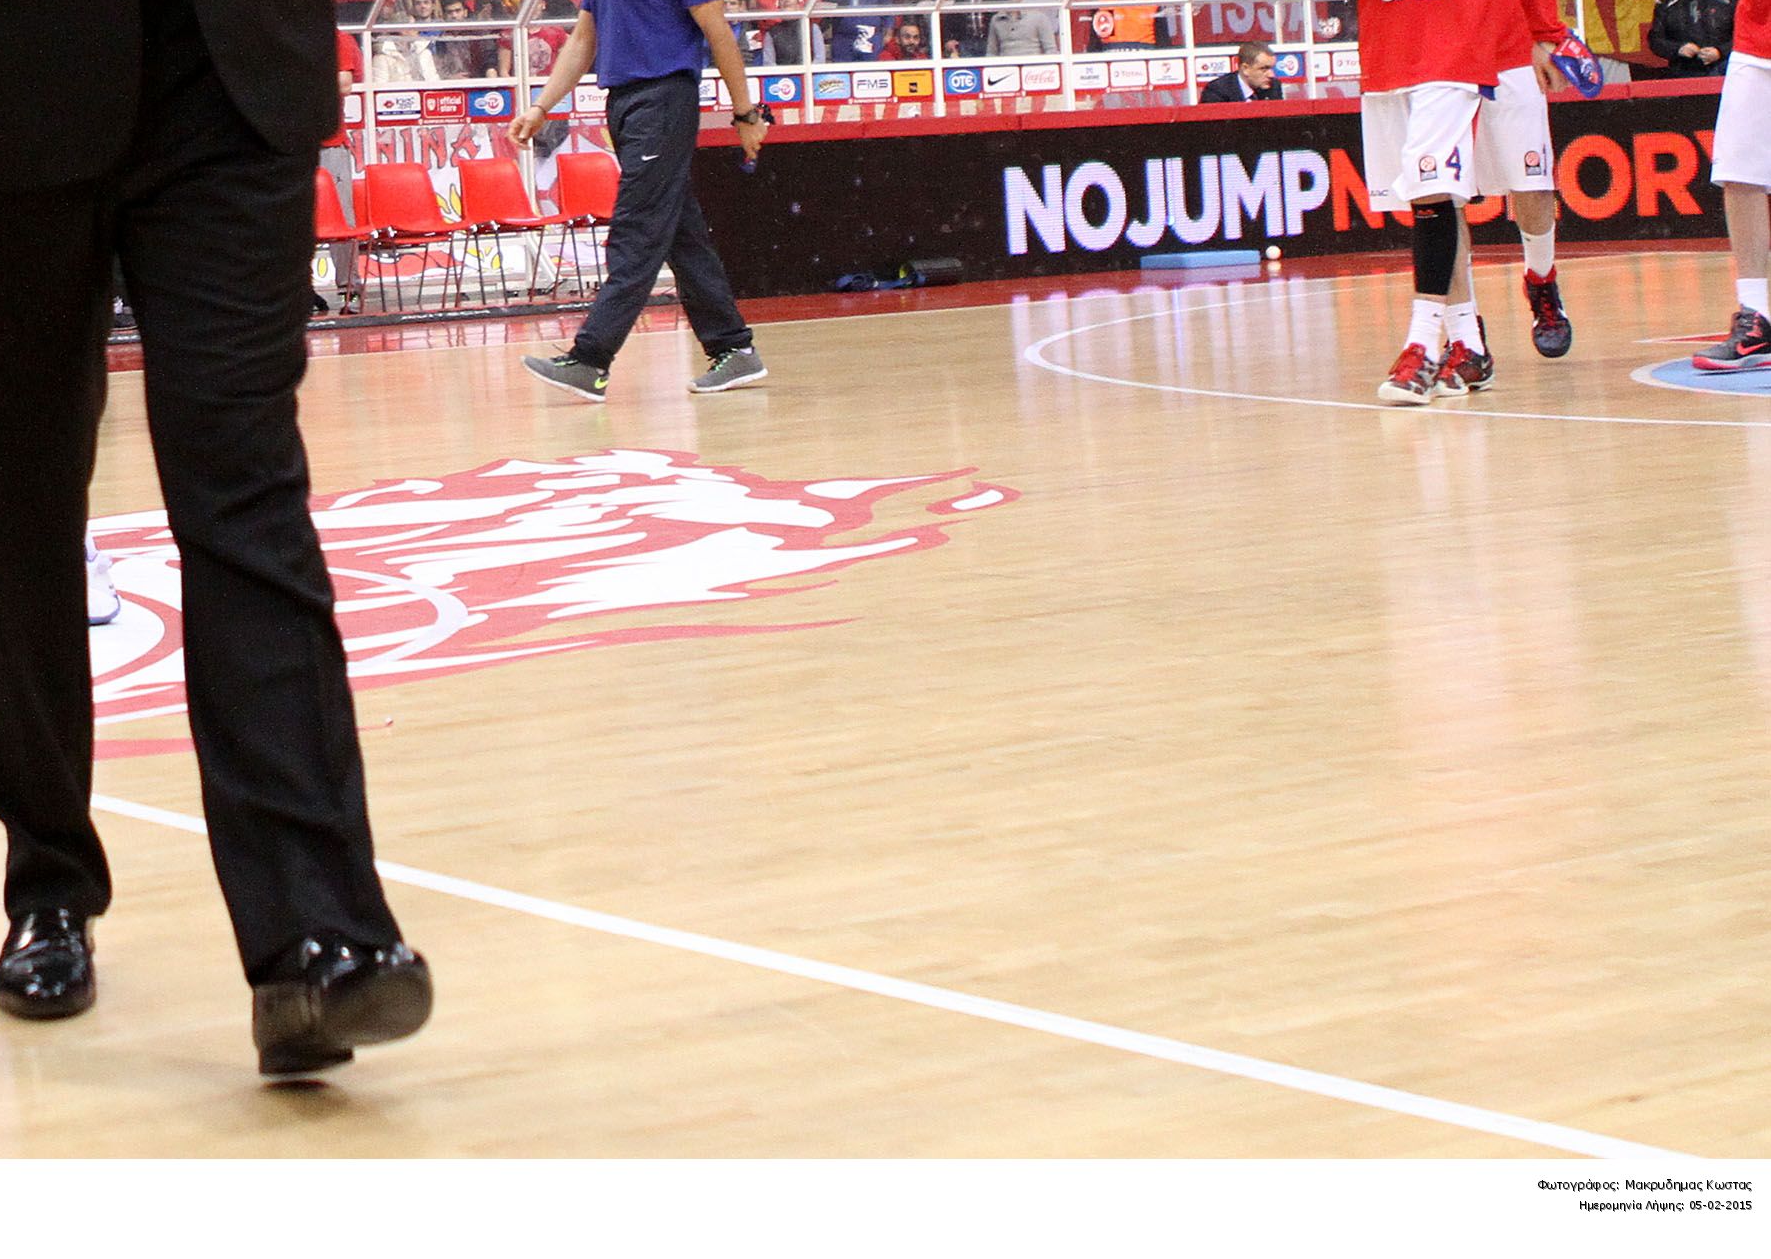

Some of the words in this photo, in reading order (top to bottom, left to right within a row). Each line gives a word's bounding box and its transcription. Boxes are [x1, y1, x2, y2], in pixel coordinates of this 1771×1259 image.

[857, 79, 889, 89] FMS
[587, 94, 608, 102] TOTA
[1445, 145, 1462, 182] 4
